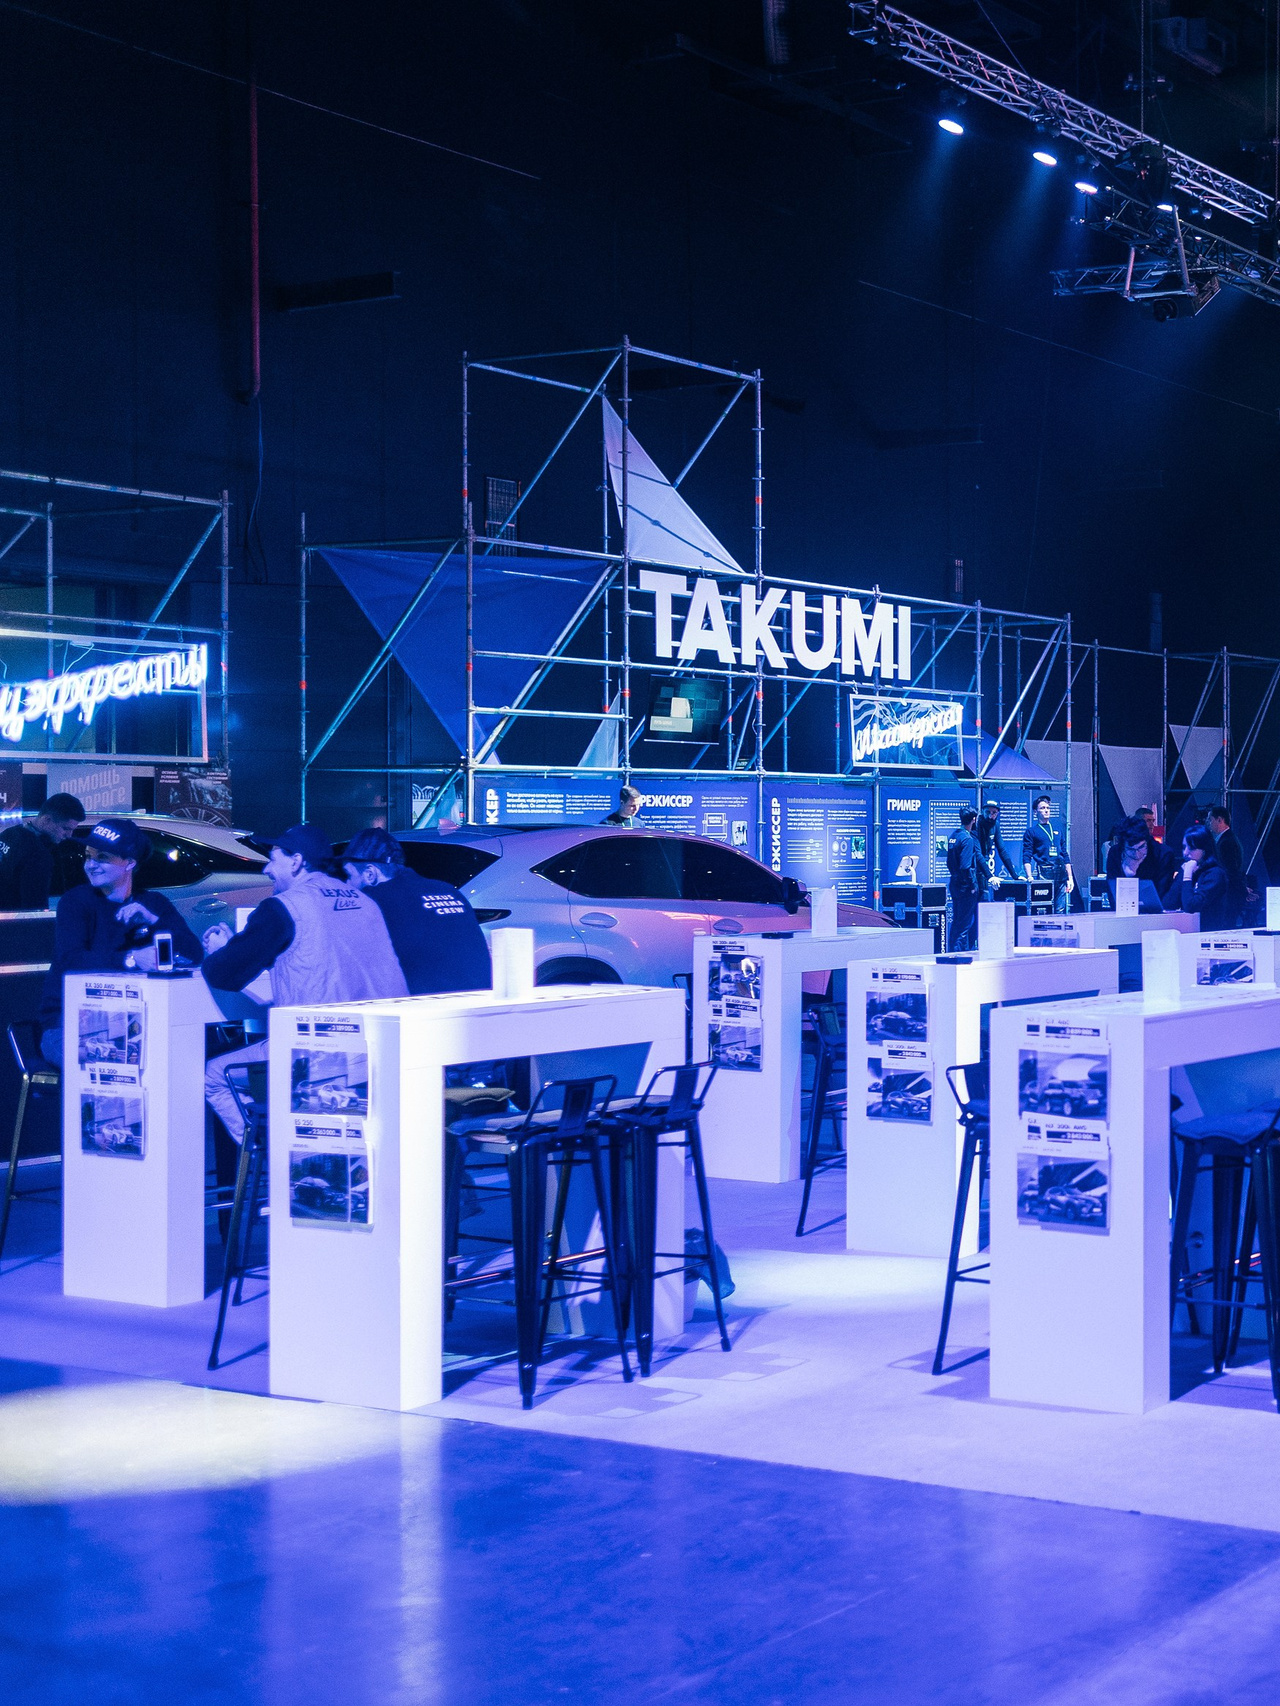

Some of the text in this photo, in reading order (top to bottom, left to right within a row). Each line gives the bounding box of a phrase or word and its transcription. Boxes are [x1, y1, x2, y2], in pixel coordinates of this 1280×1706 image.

[639, 569, 911, 681] TAKUMI
[640, 794, 693, 808] РЕЖИССЕР
[887, 799, 921, 812] ГРИМЕР
[93, 825, 120, 842] CREW
[320, 888, 360, 899] LEXUS
[422, 894, 455, 902] LEXUS
[423, 901, 465, 909] CINEMA
[436, 907, 465, 915] CREW
